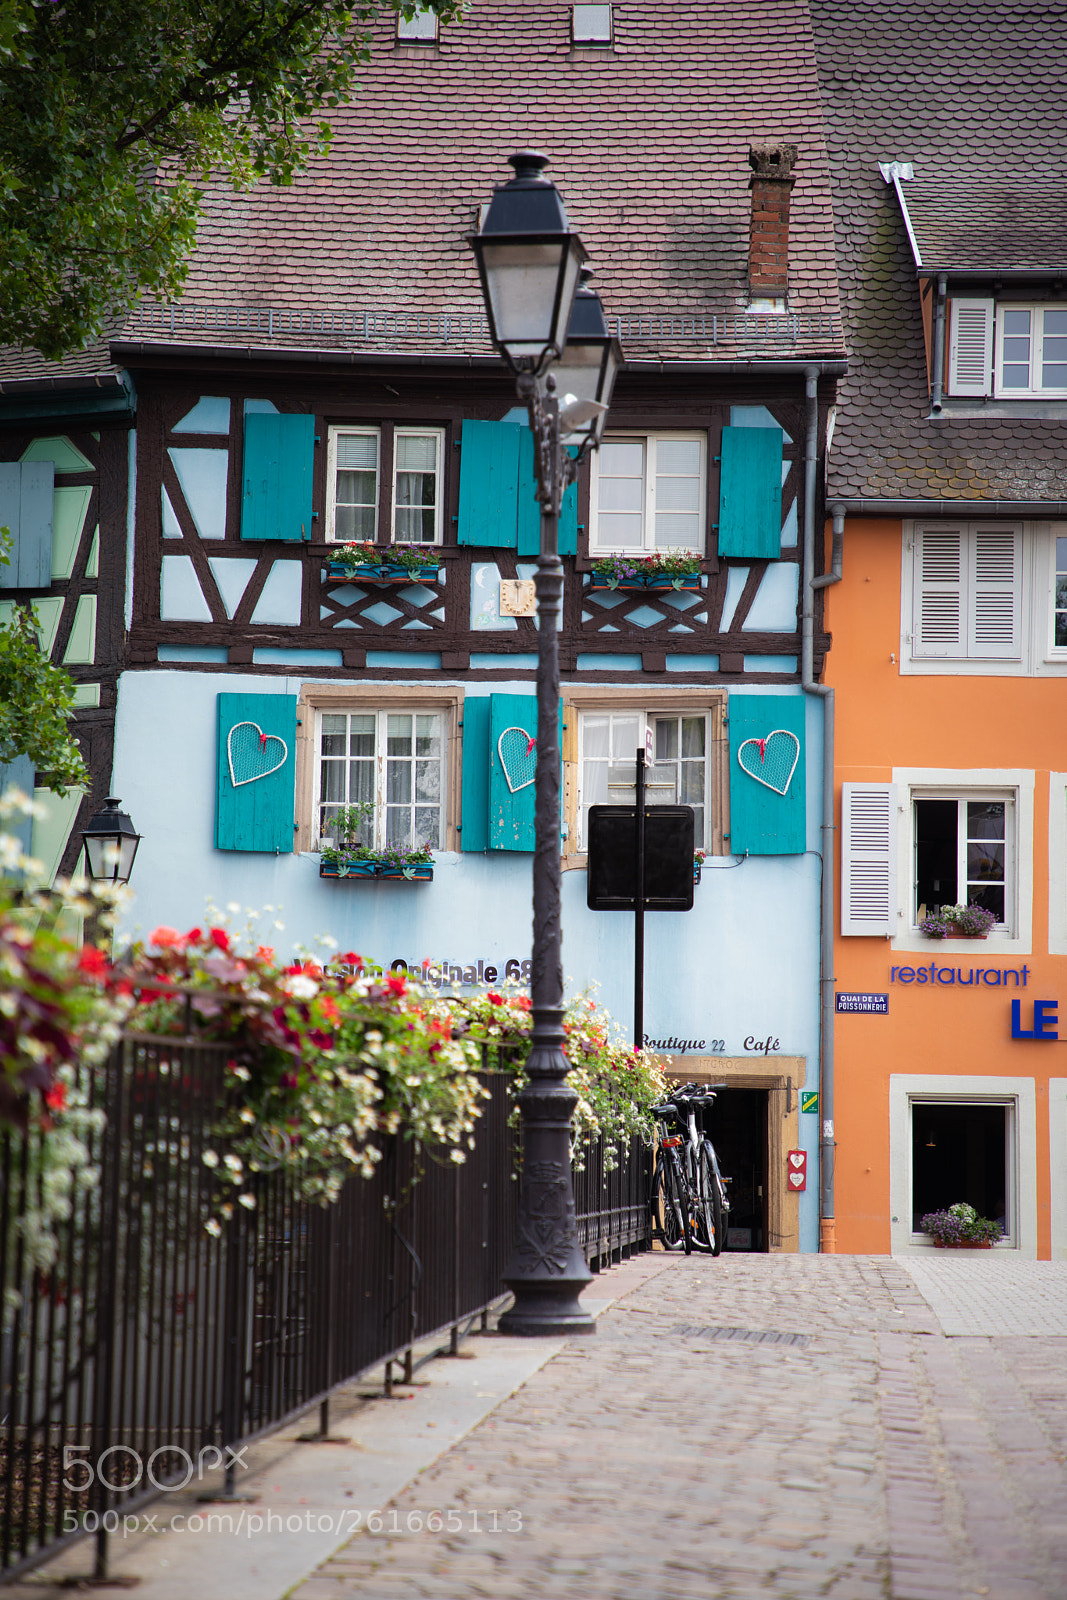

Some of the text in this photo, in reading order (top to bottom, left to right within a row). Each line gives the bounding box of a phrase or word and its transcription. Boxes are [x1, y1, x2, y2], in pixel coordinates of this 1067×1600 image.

[391, 959, 498, 988] Originale
[890, 962, 1030, 986] restaurant
[838, 1002, 887, 1011] POISSONNERIE
[862, 995, 873, 1003] DE
[1011, 999, 1059, 1040] LE
[643, 1033, 781, 1056] Boutique 22 Café
